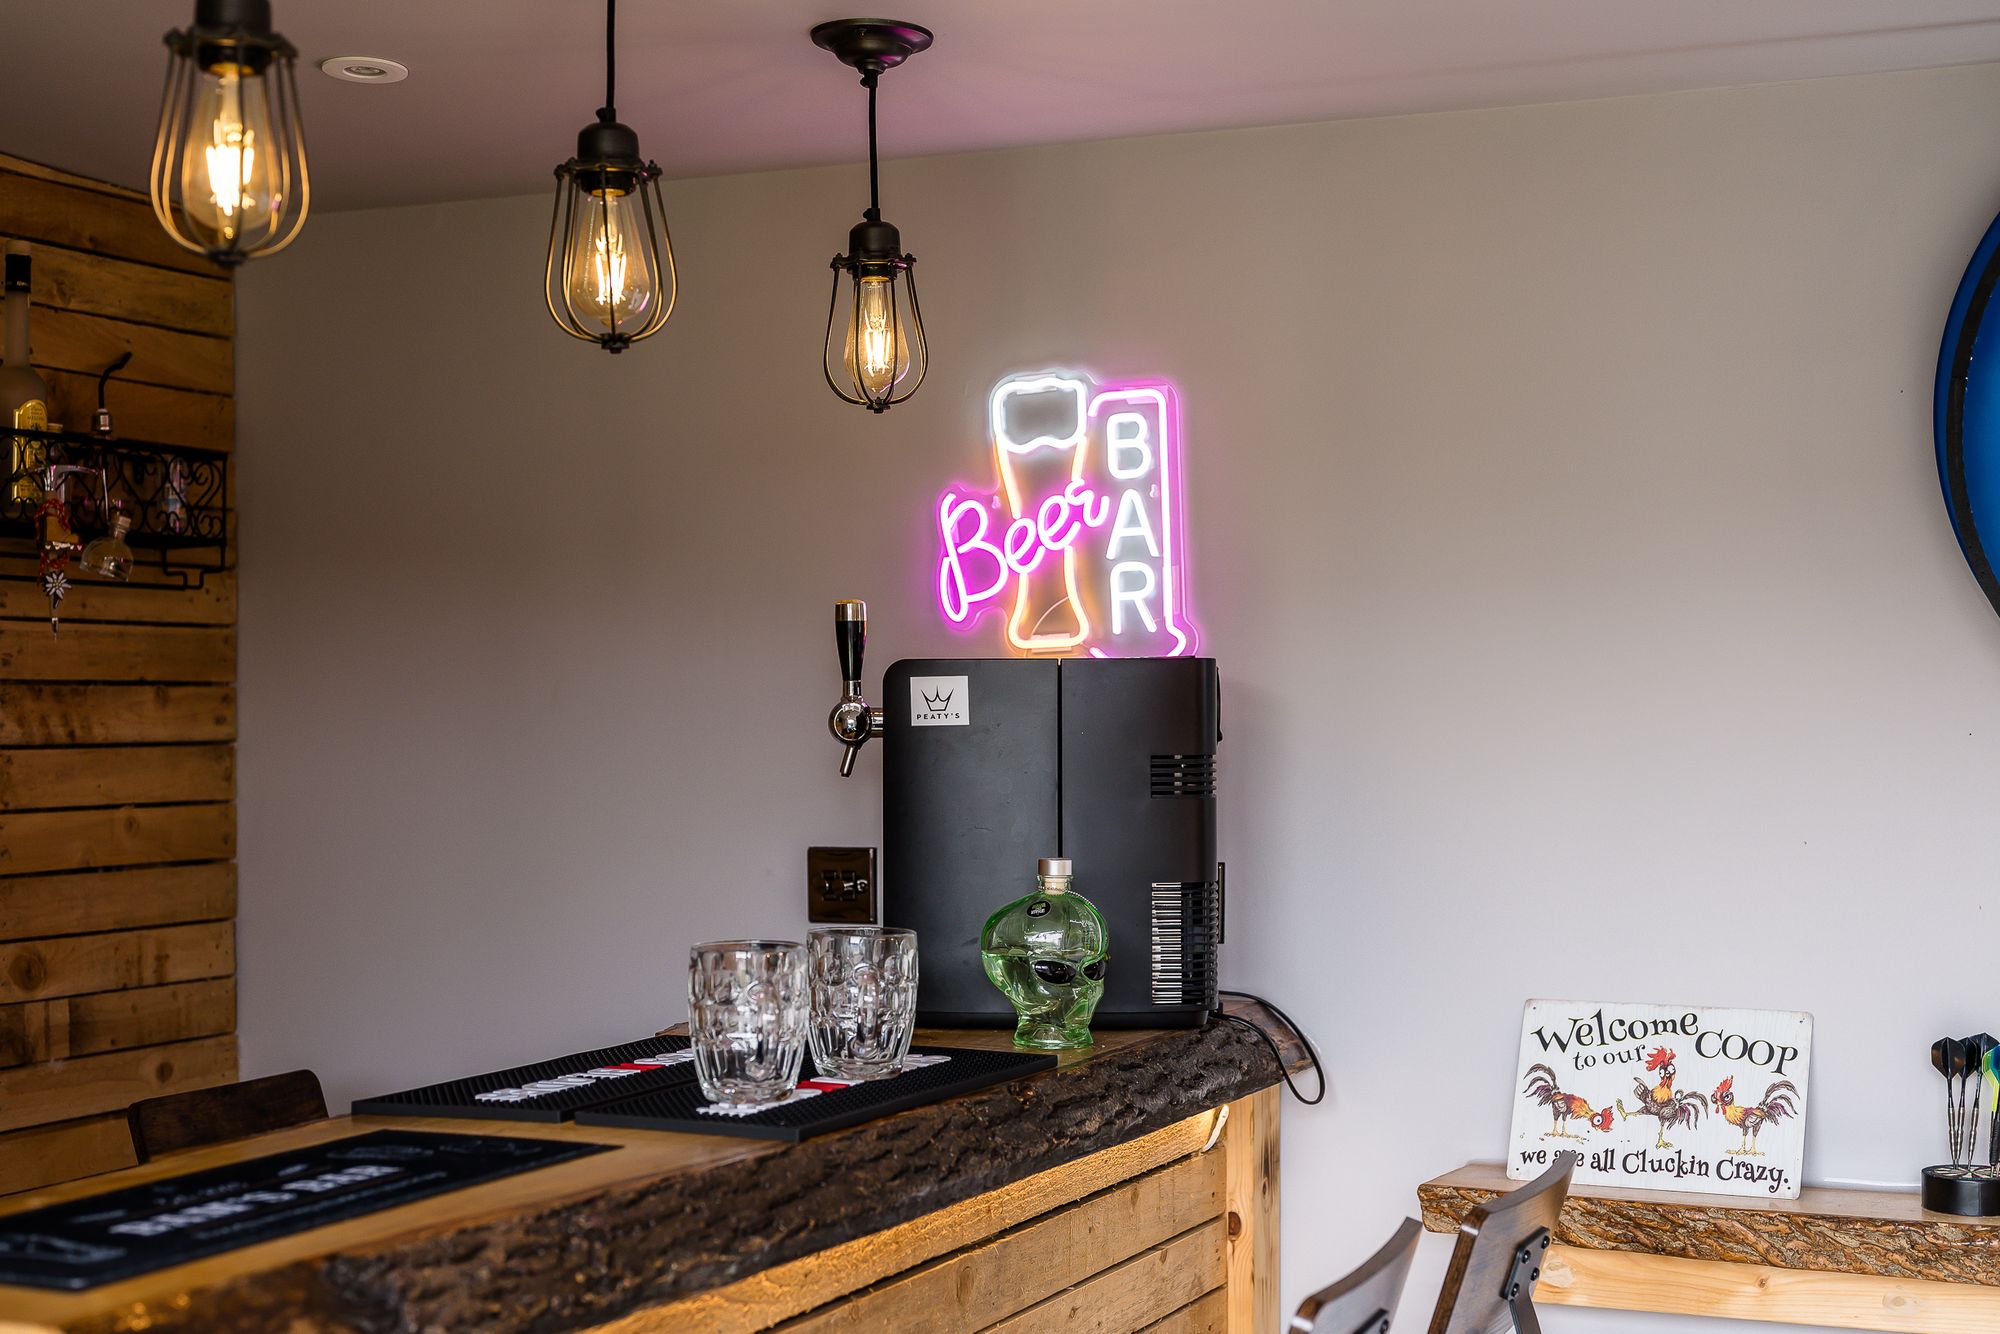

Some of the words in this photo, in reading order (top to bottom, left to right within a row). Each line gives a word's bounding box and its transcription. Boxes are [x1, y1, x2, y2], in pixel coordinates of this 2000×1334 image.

[1106, 412, 1159, 635] BAR
[940, 478, 1110, 622] Beer
[916, 712, 961, 720] PEATY'S
[1530, 1008, 1699, 1054] Welcome
[1573, 1051, 1597, 1071] to
[1603, 1045, 1646, 1065] our
[1520, 1149, 1547, 1165] we
[1590, 1147, 1616, 1173] all
[1622, 1149, 1710, 1179] Cluckin
[1715, 1157, 1790, 1194] Crazy.
